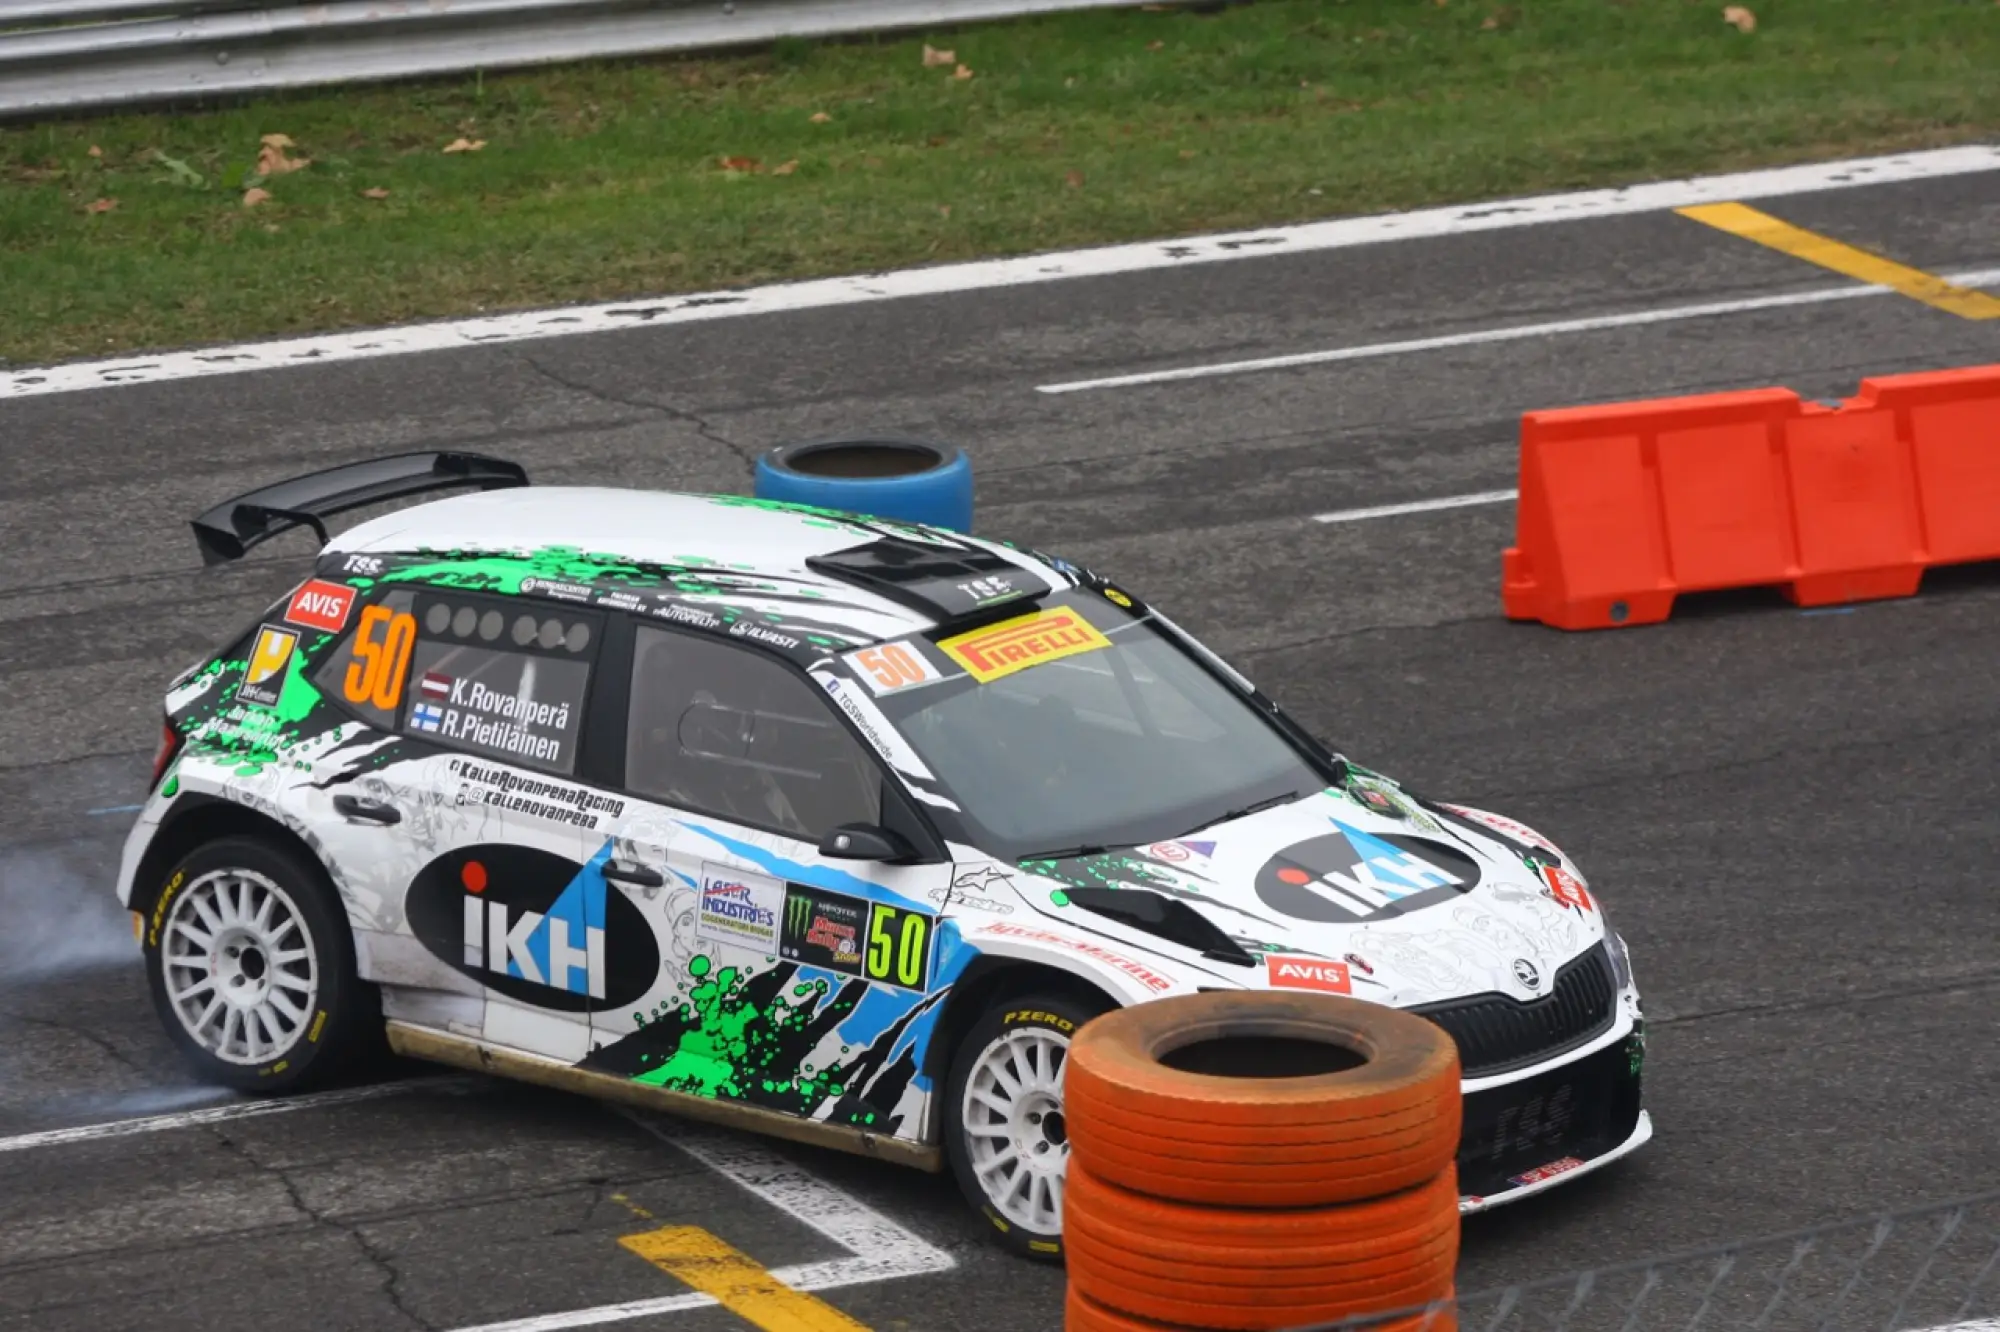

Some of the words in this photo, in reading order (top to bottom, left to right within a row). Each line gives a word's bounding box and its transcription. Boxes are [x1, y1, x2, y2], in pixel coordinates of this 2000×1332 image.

[295, 591, 343, 618] AVIS
[344, 604, 417, 710] 50
[854, 644, 927, 688] 50
[954, 615, 1093, 673] PIRELLI
[450, 677, 570, 730] K.Rovanperä
[441, 708, 561, 762] R.Pietiläinen
[867, 904, 926, 987] 50
[1278, 963, 1344, 984] AVIS
